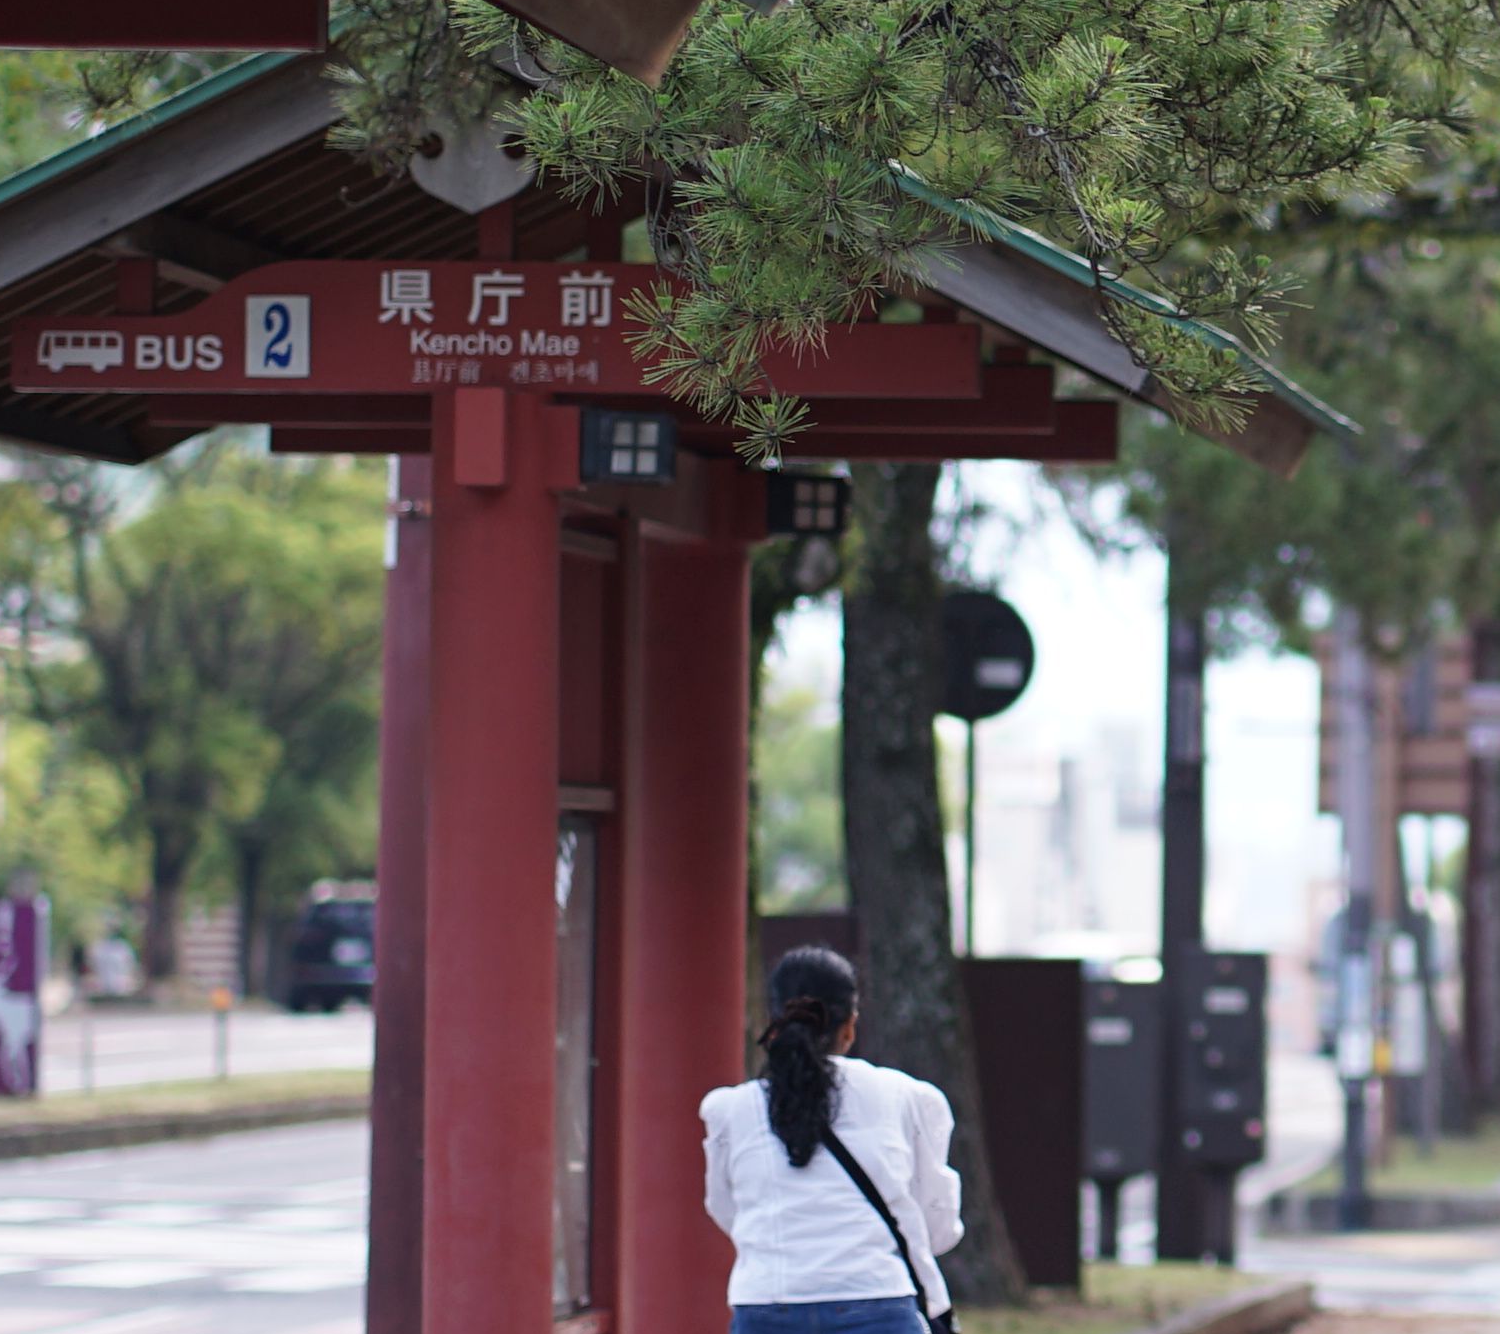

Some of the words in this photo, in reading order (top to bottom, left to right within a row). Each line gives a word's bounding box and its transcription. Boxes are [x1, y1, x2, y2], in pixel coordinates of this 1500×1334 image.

[377, 269, 614, 328] 県庁前
[135, 335, 223, 370] BUS
[262, 303, 294, 368] 2
[410, 329, 513, 356] Kencho
[520, 330, 580, 356] Mae
